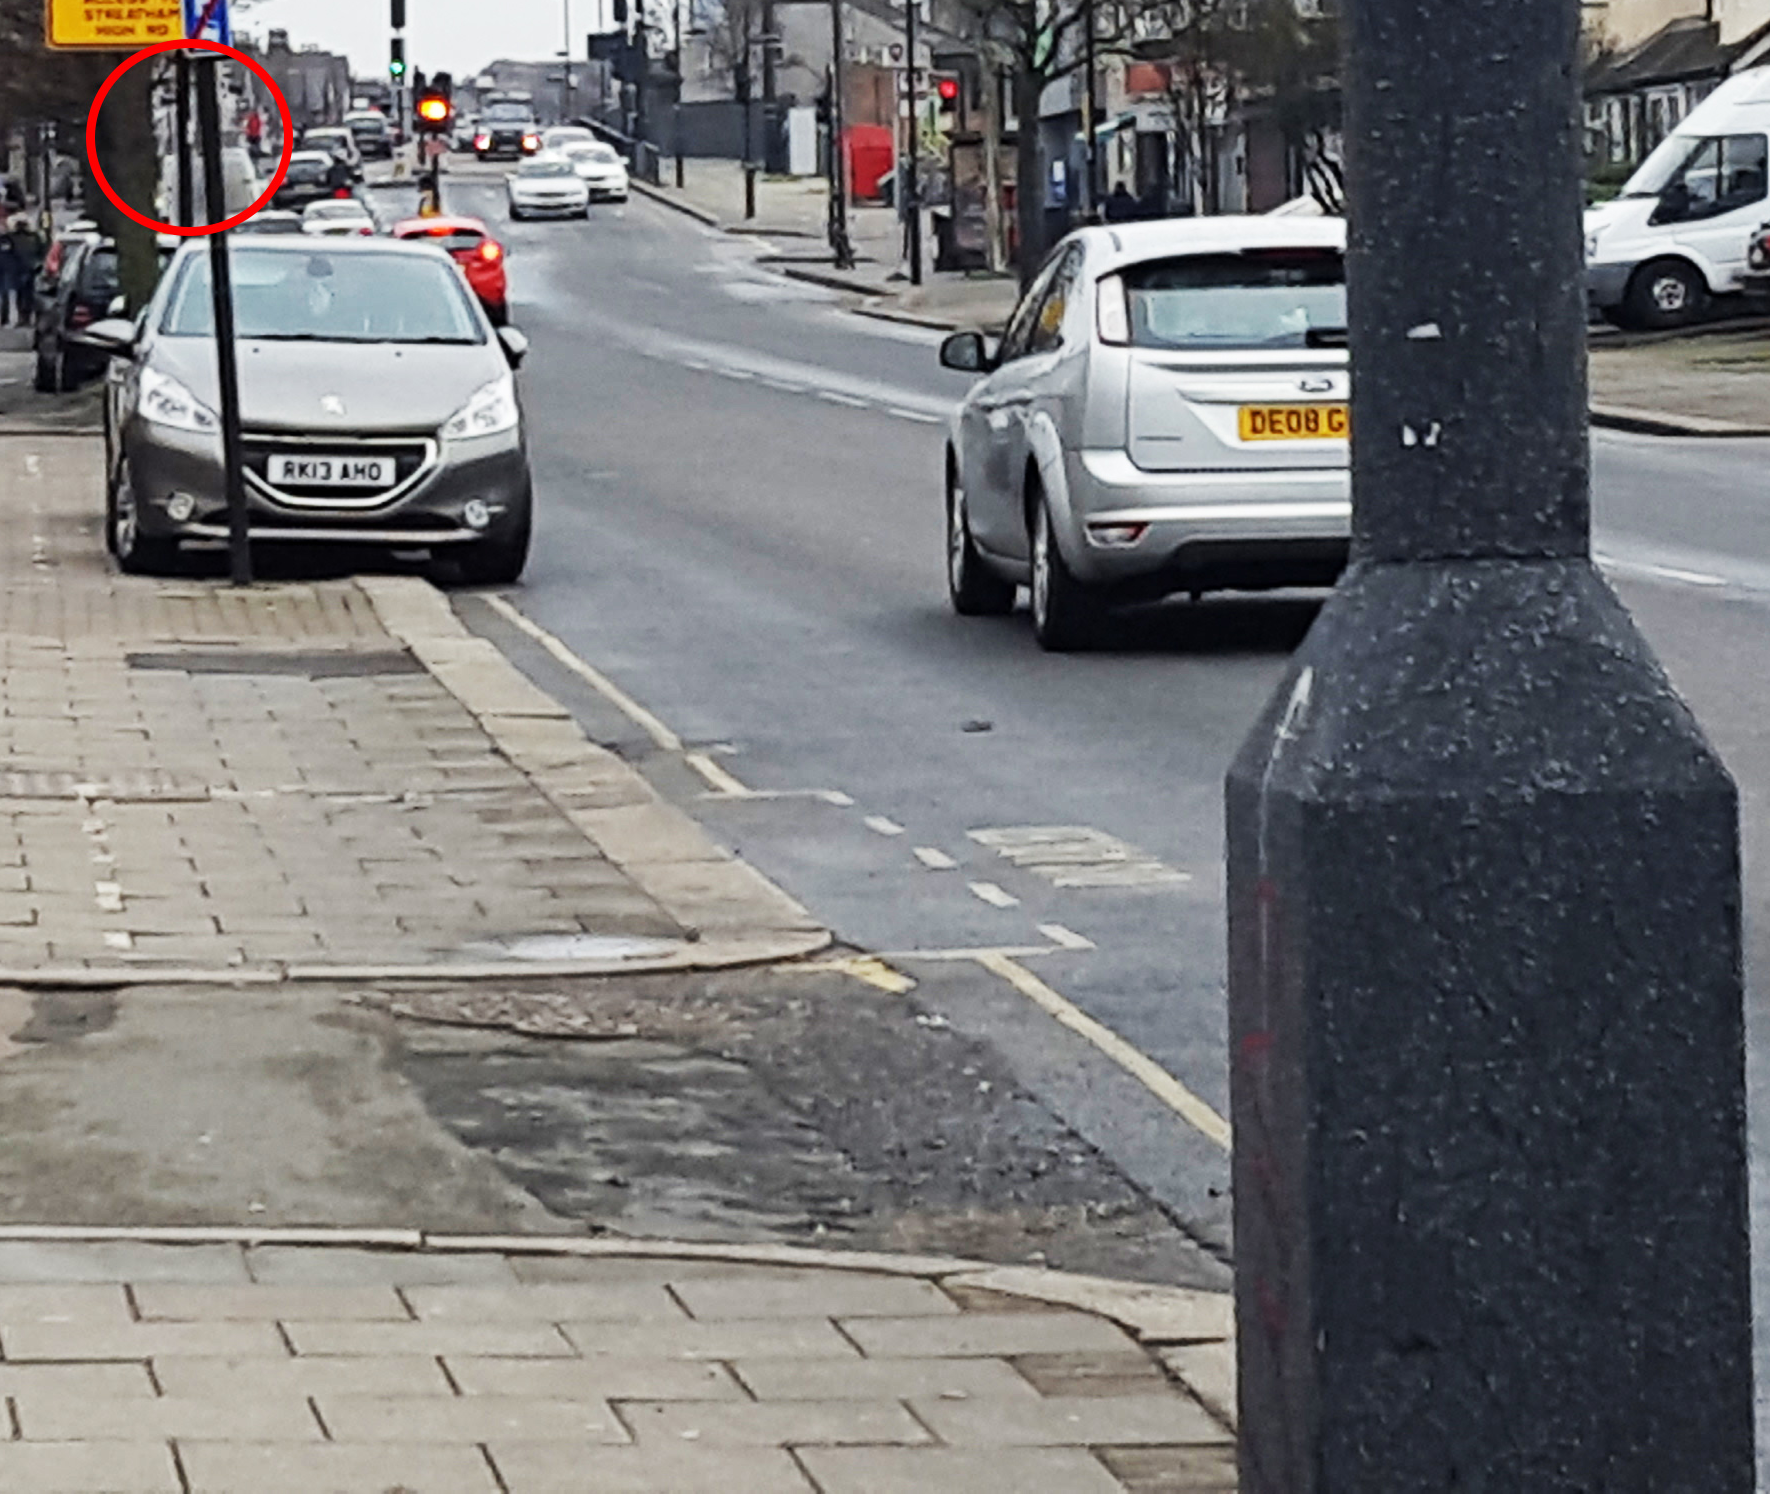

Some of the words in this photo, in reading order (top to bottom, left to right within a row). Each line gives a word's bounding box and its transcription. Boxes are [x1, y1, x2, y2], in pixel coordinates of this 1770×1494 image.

[84, 8, 181, 21] STREATHAM
[1250, 408, 1319, 435] DE08
[1327, 408, 1345, 433] G
[283, 460, 332, 481] RK13
